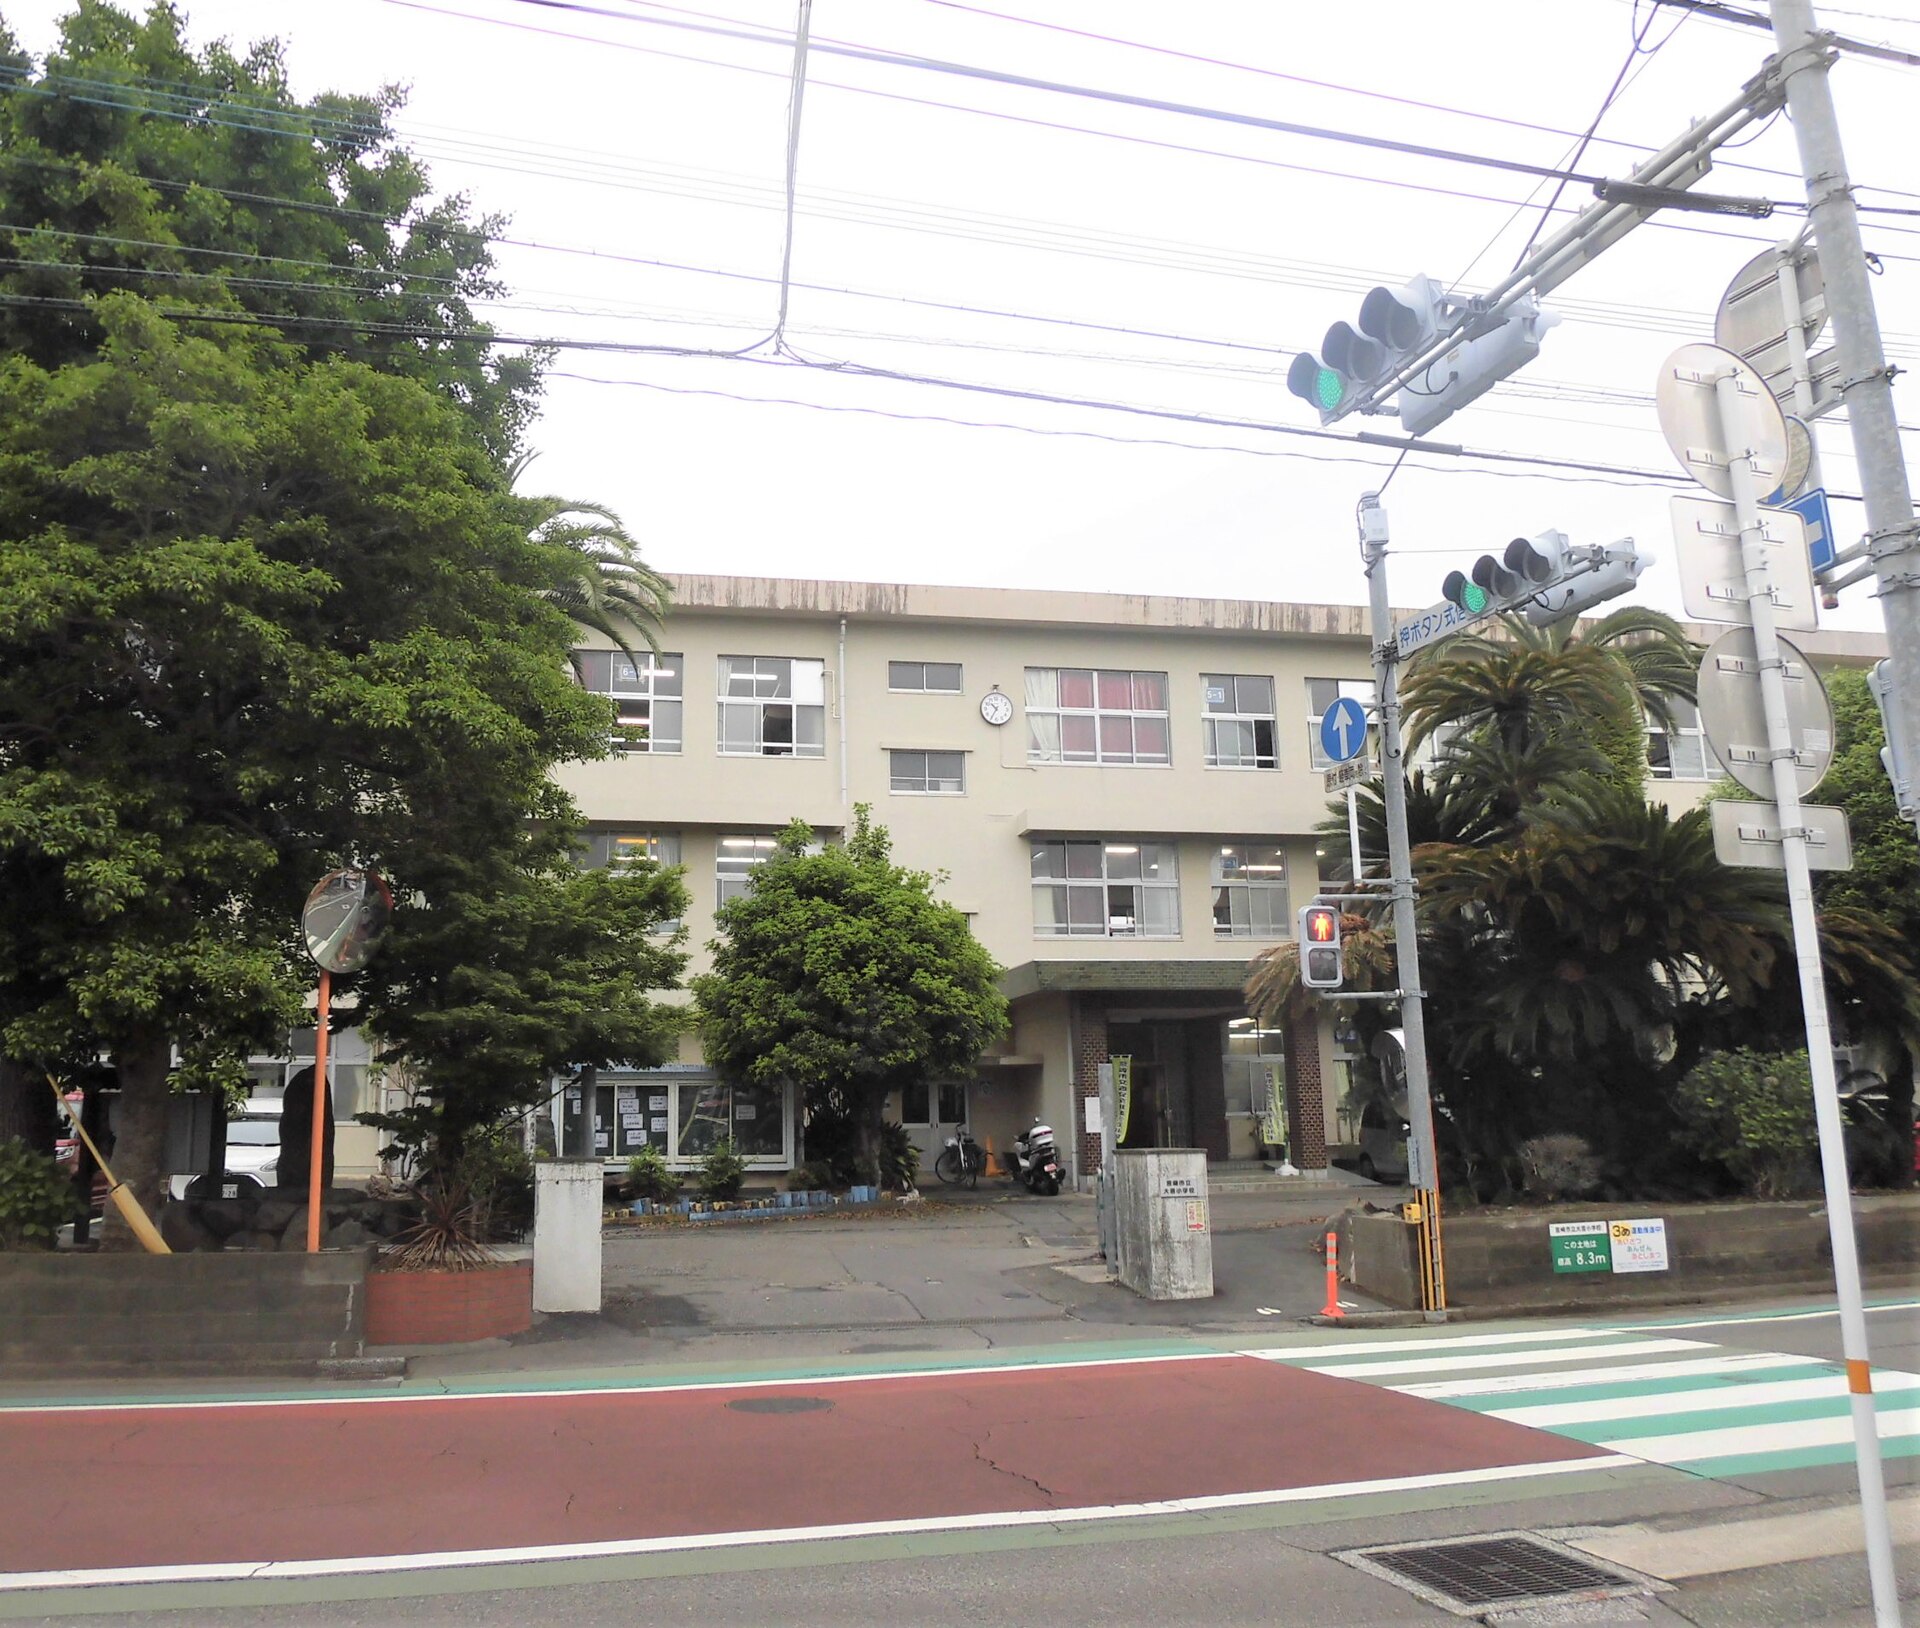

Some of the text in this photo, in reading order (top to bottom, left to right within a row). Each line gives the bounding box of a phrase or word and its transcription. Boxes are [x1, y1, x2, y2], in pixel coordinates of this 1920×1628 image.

[1207, 690, 1222, 699] 5-1
[1563, 1240, 1597, 1249] この土地は
[1576, 1251, 1606, 1265] 8.3m
